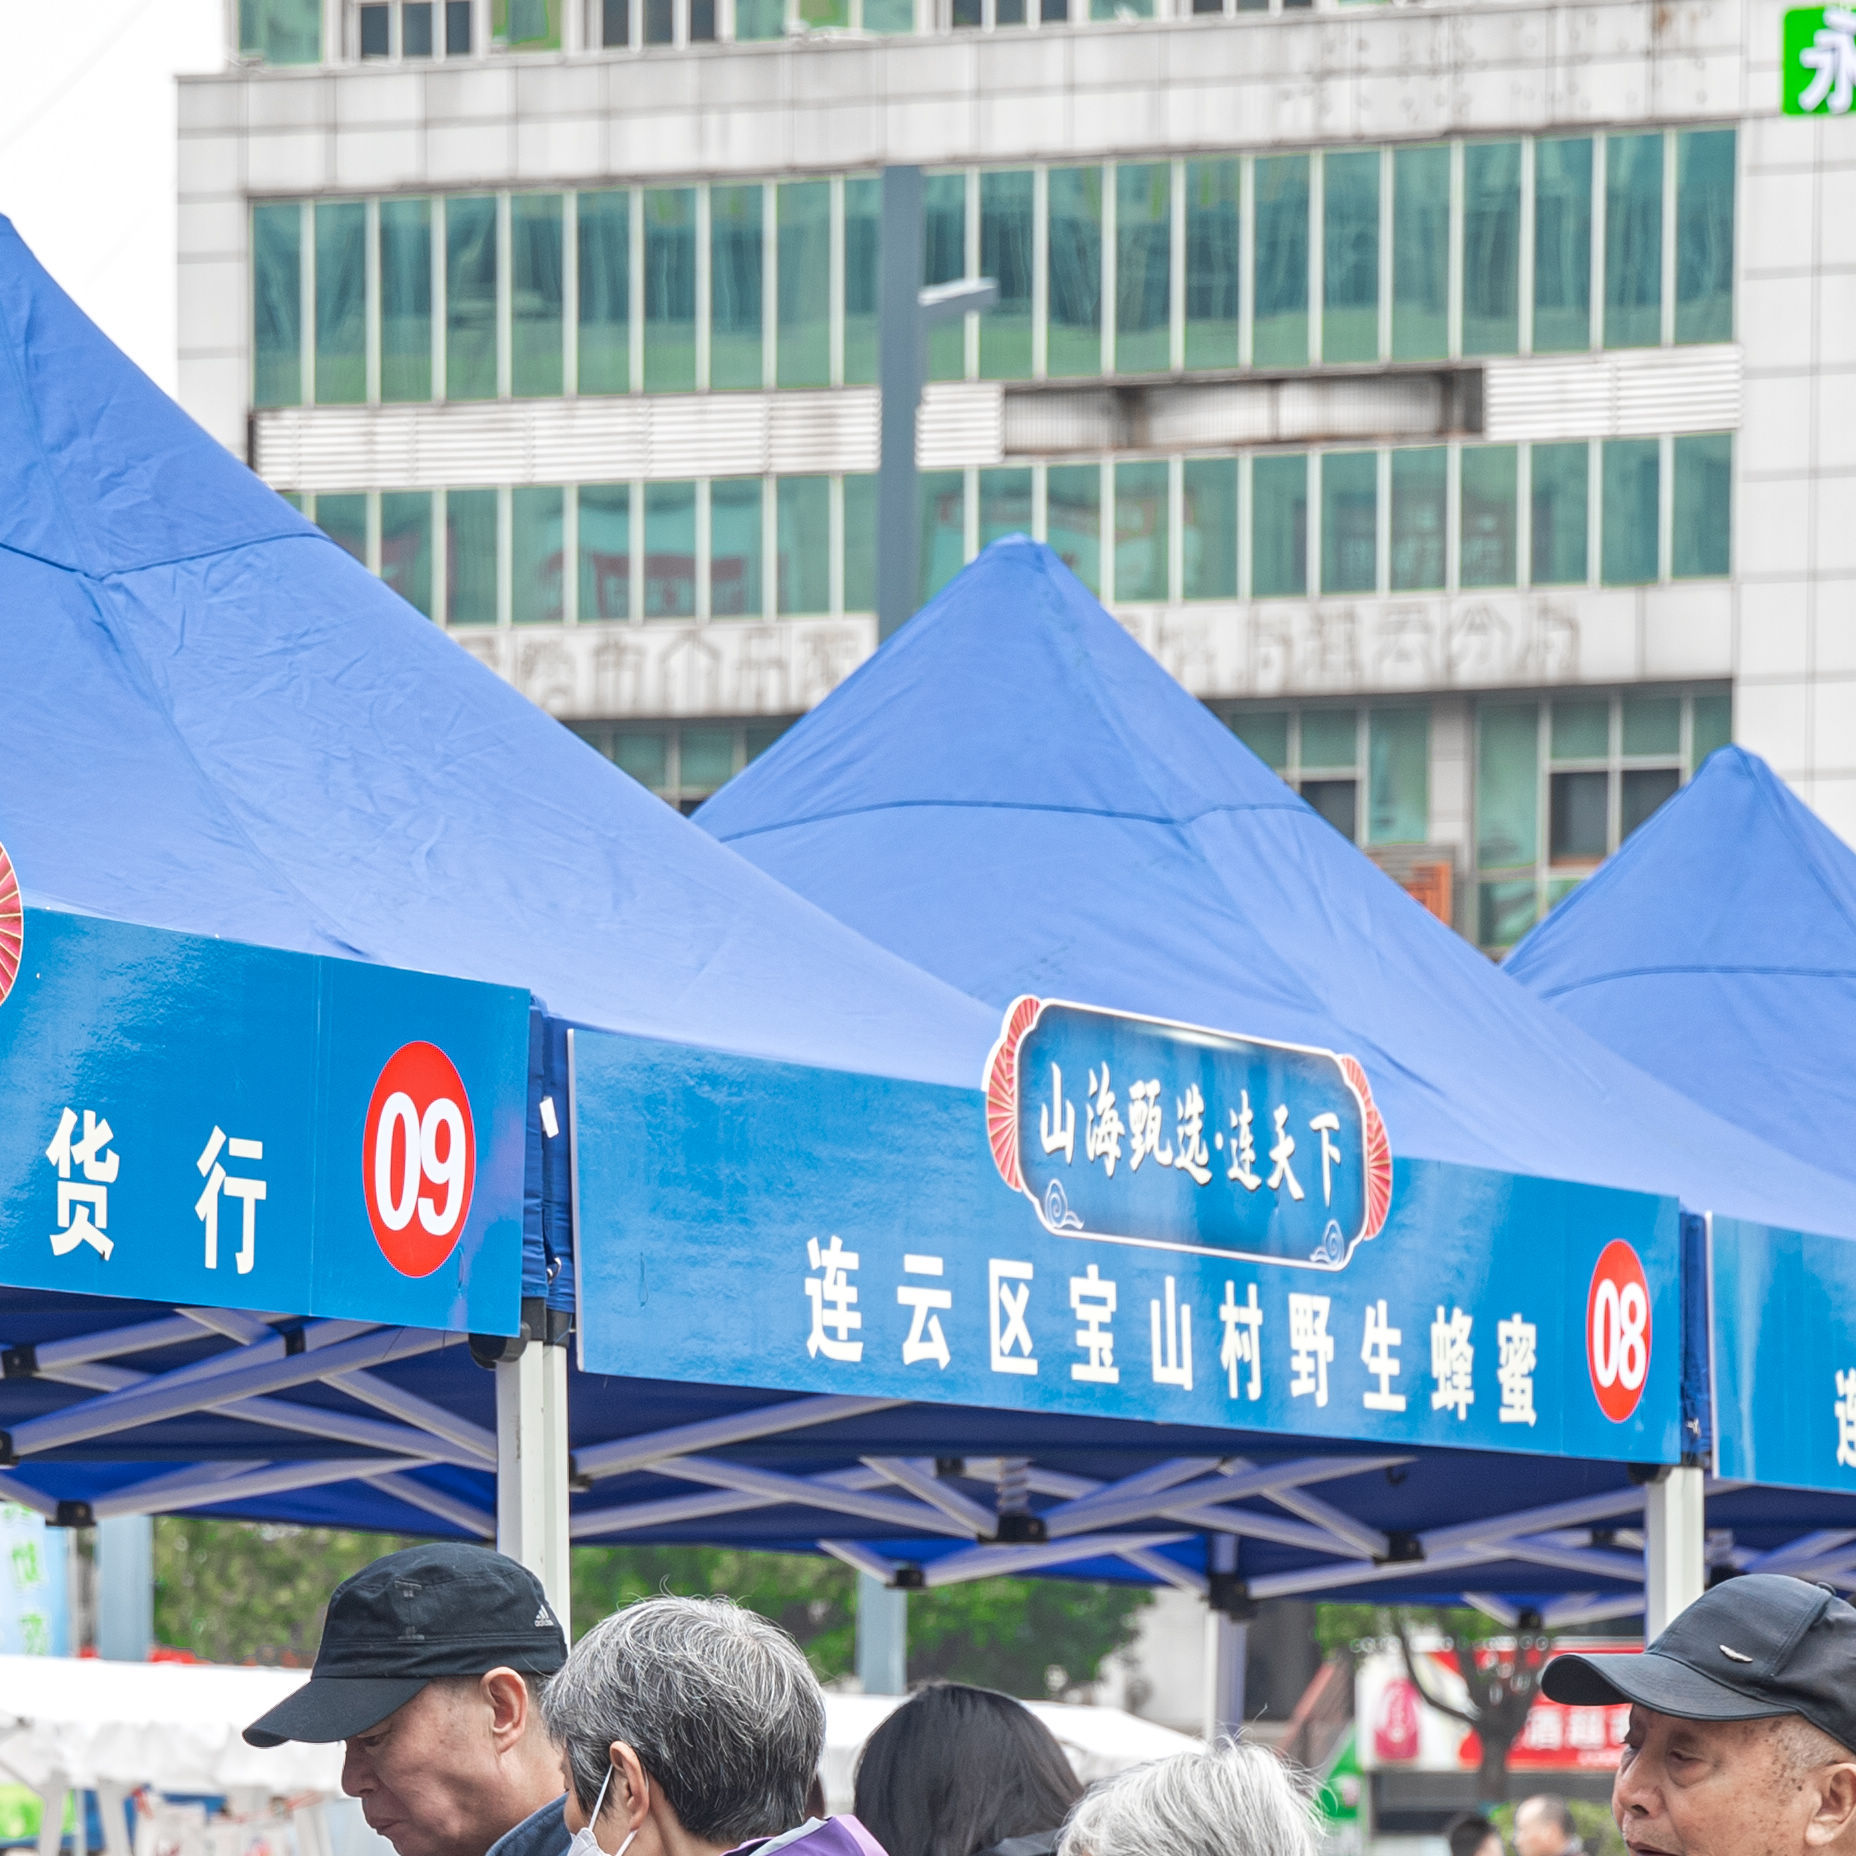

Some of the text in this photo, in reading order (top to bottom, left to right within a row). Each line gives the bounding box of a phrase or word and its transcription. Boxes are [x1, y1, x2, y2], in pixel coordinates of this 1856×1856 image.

[374, 1090, 466, 1237] 09
[804, 1235, 1537, 1428] 连云区宝山村野生蜂蜜
[1591, 1277, 1646, 1391] 08
